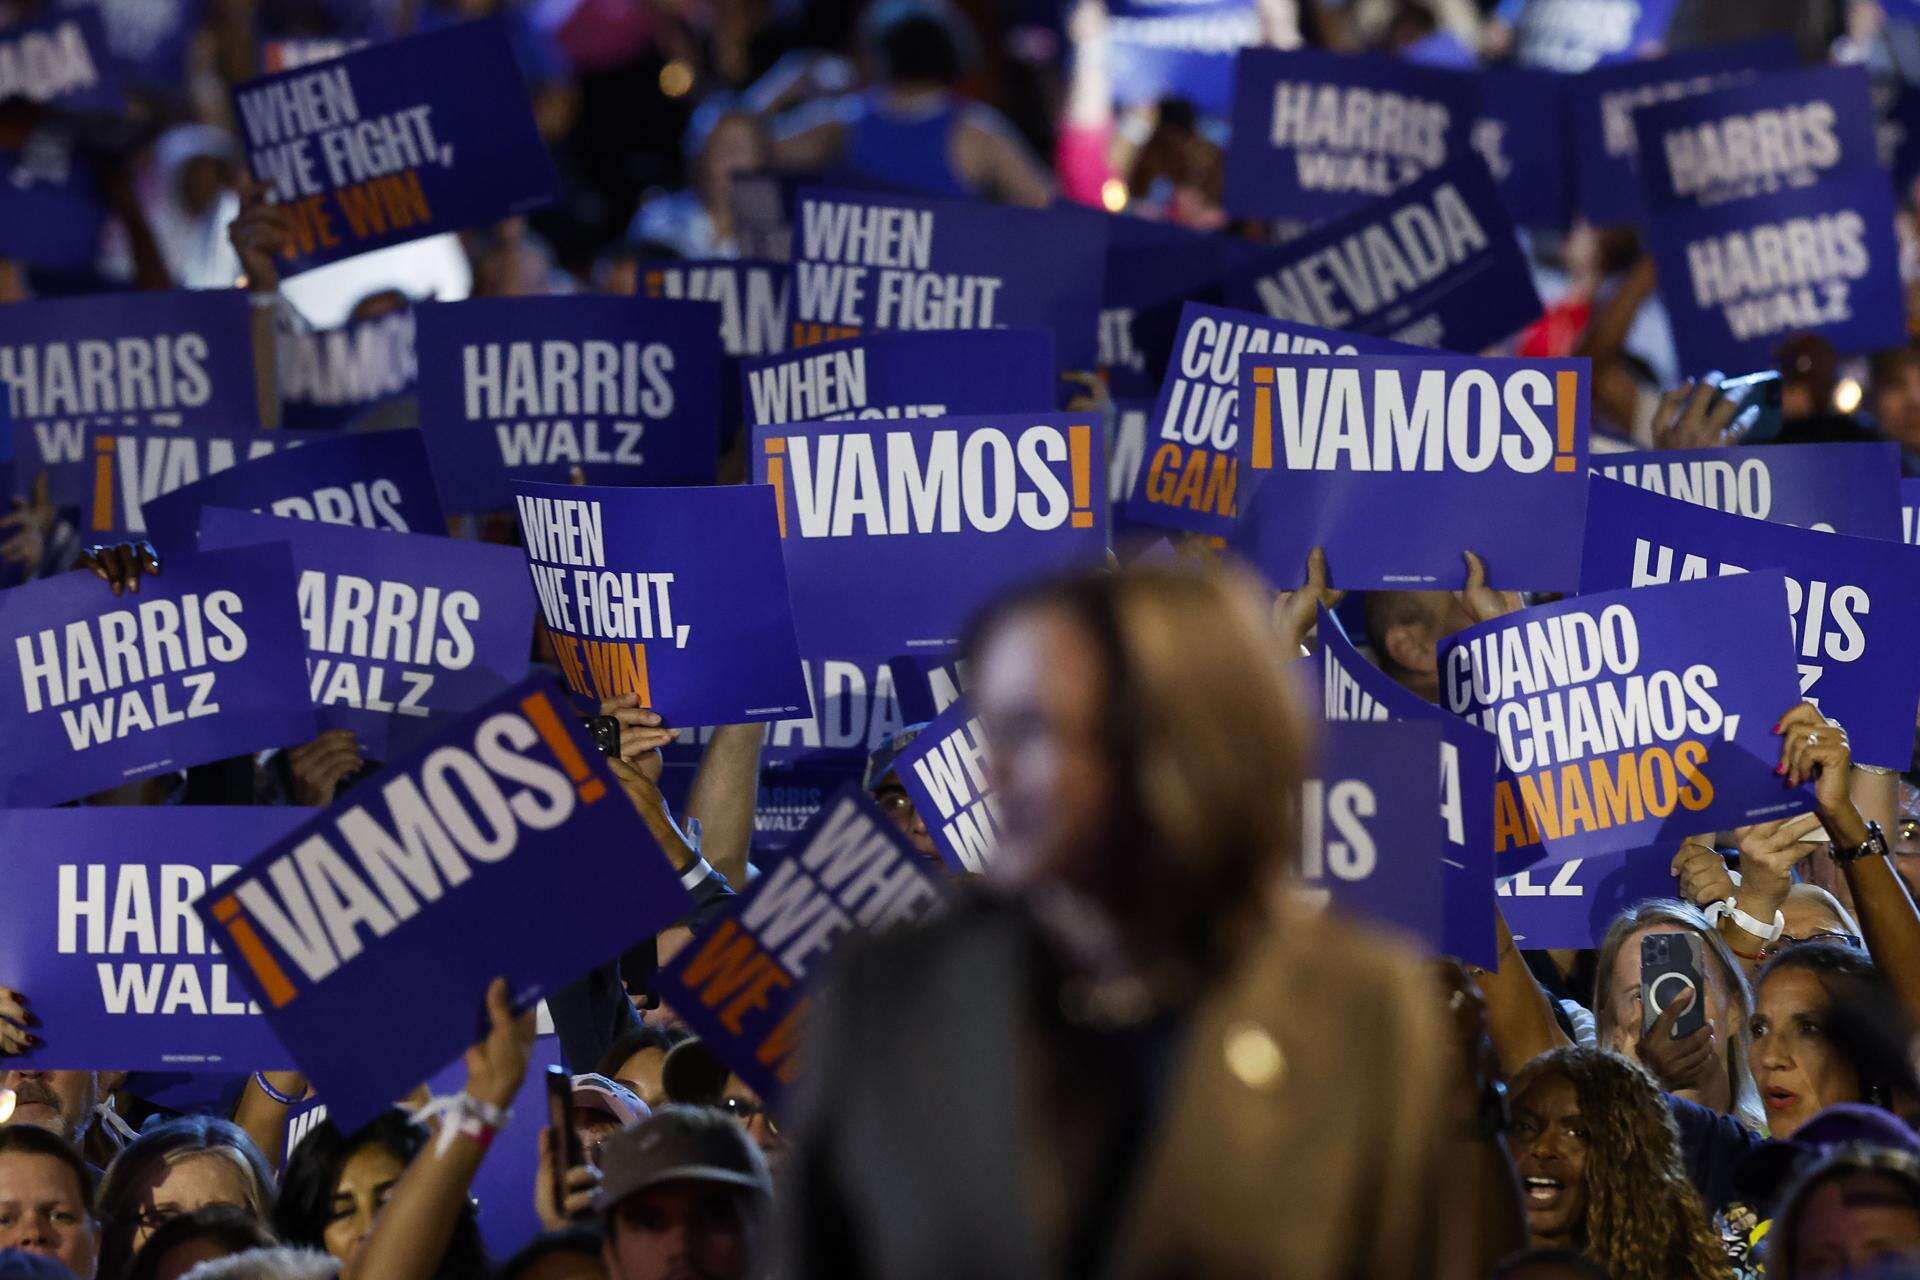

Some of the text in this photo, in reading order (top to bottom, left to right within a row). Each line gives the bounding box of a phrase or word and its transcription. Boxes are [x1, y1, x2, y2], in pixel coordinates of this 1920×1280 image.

[239, 65, 360, 147] WHEN
[1270, 82, 1451, 172] HARRIS
[1664, 101, 1842, 197] HARRIS
[252, 104, 453, 203] WE FIGHT,
[334, 168, 433, 241] WIN
[803, 199, 933, 271] WHEN
[797, 259, 1009, 332] WE FIGHT
[1256, 182, 1489, 332] NEVADA
[1686, 210, 1870, 309] HARRIS
[1722, 277, 1853, 342] WALZ
[0, 332, 212, 417] HARRIS
[463, 340, 676, 421] HARRIS
[749, 347, 867, 425] WHEN
[496, 420, 644, 467] WALZ
[1251, 366, 1578, 474] ¡VAMOS!
[764, 425, 1094, 539] ¡VAMOS!
[516, 494, 606, 567] WHEN
[297, 569, 481, 671] ARRIS
[529, 563, 691, 649] WE FIGHT,
[15, 589, 248, 714] HARRIS
[547, 630, 652, 708] WE WIN
[1447, 603, 1640, 715] CUANDO
[60, 671, 220, 751] WALZ
[1465, 664, 1741, 774] CHAMOS,
[1494, 740, 1715, 853] ANAMOS
[210, 690, 607, 1009] ¡VAMOS!
[740, 857, 853, 977] WE
[96, 963, 263, 1016] WAL
[681, 918, 792, 1036] WE
